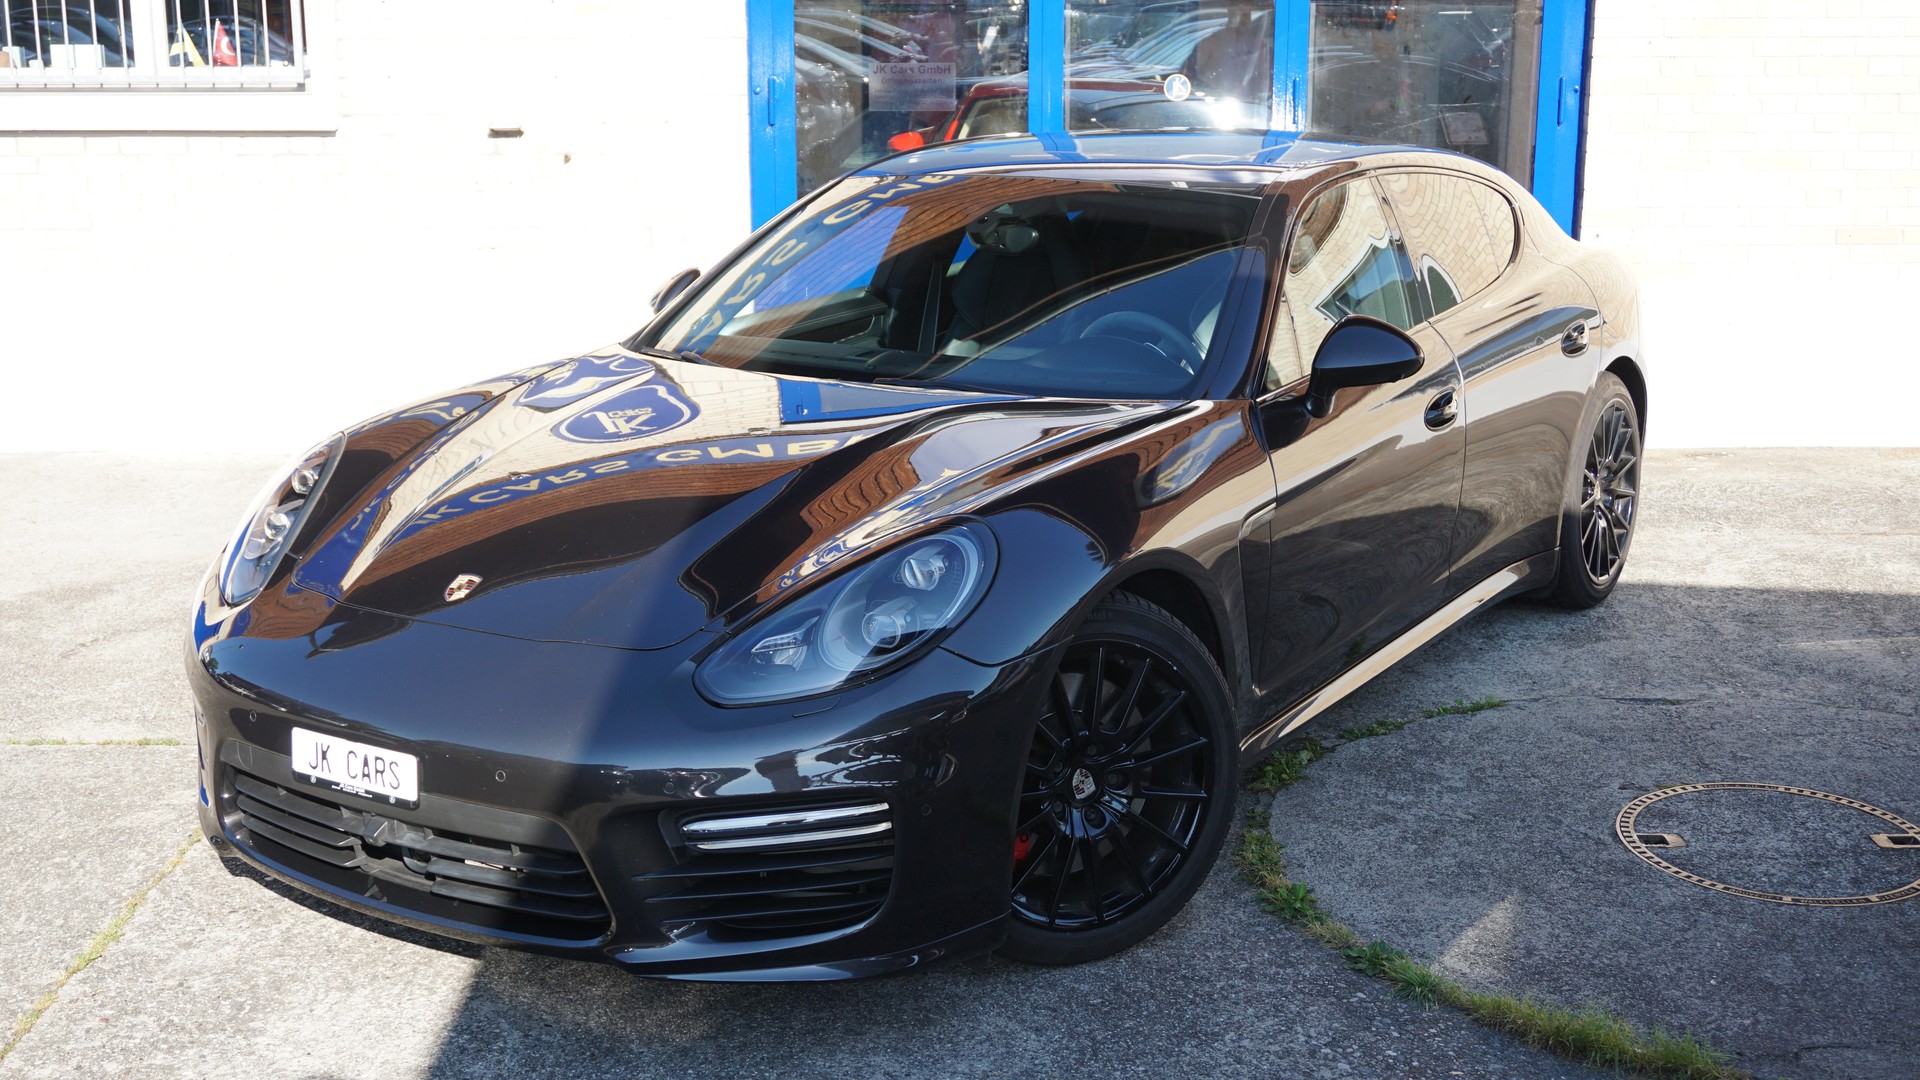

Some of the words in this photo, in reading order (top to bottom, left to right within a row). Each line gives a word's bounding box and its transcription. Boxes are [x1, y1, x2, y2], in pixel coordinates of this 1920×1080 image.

[872, 65, 887, 74] JK
[918, 65, 951, 74] GmbH
[308, 742, 332, 774] JK
[346, 750, 401, 790] CARS
